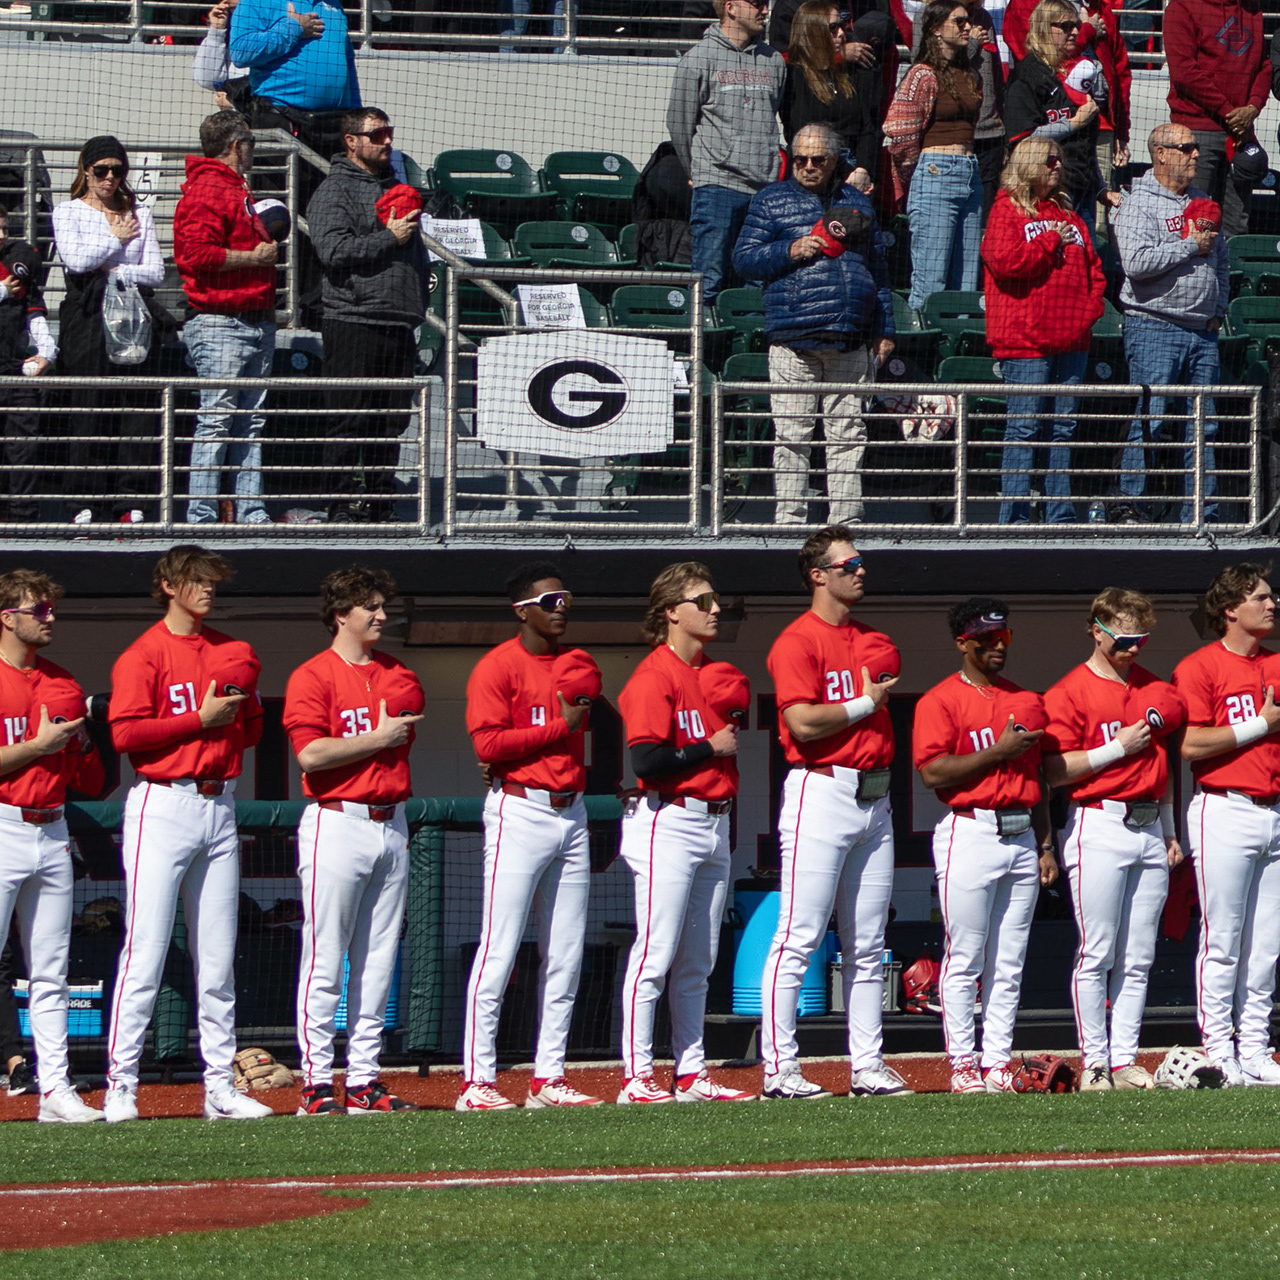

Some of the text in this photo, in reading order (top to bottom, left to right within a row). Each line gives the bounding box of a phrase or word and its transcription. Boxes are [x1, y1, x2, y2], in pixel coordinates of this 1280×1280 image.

[717, 68, 773, 85] GEORGIA
[530, 292, 566, 300] RESERVED
[535, 314, 572, 322] BASEBALL
[527, 359, 628, 429] G
[169, 682, 197, 715] 51
[826, 670, 854, 701] 20
[341, 707, 372, 738] 35
[532, 707, 545, 726] 4
[1227, 694, 1257, 725] 28
[5, 717, 26, 745] 14
[678, 710, 705, 739] 40
[969, 727, 996, 752] 10
